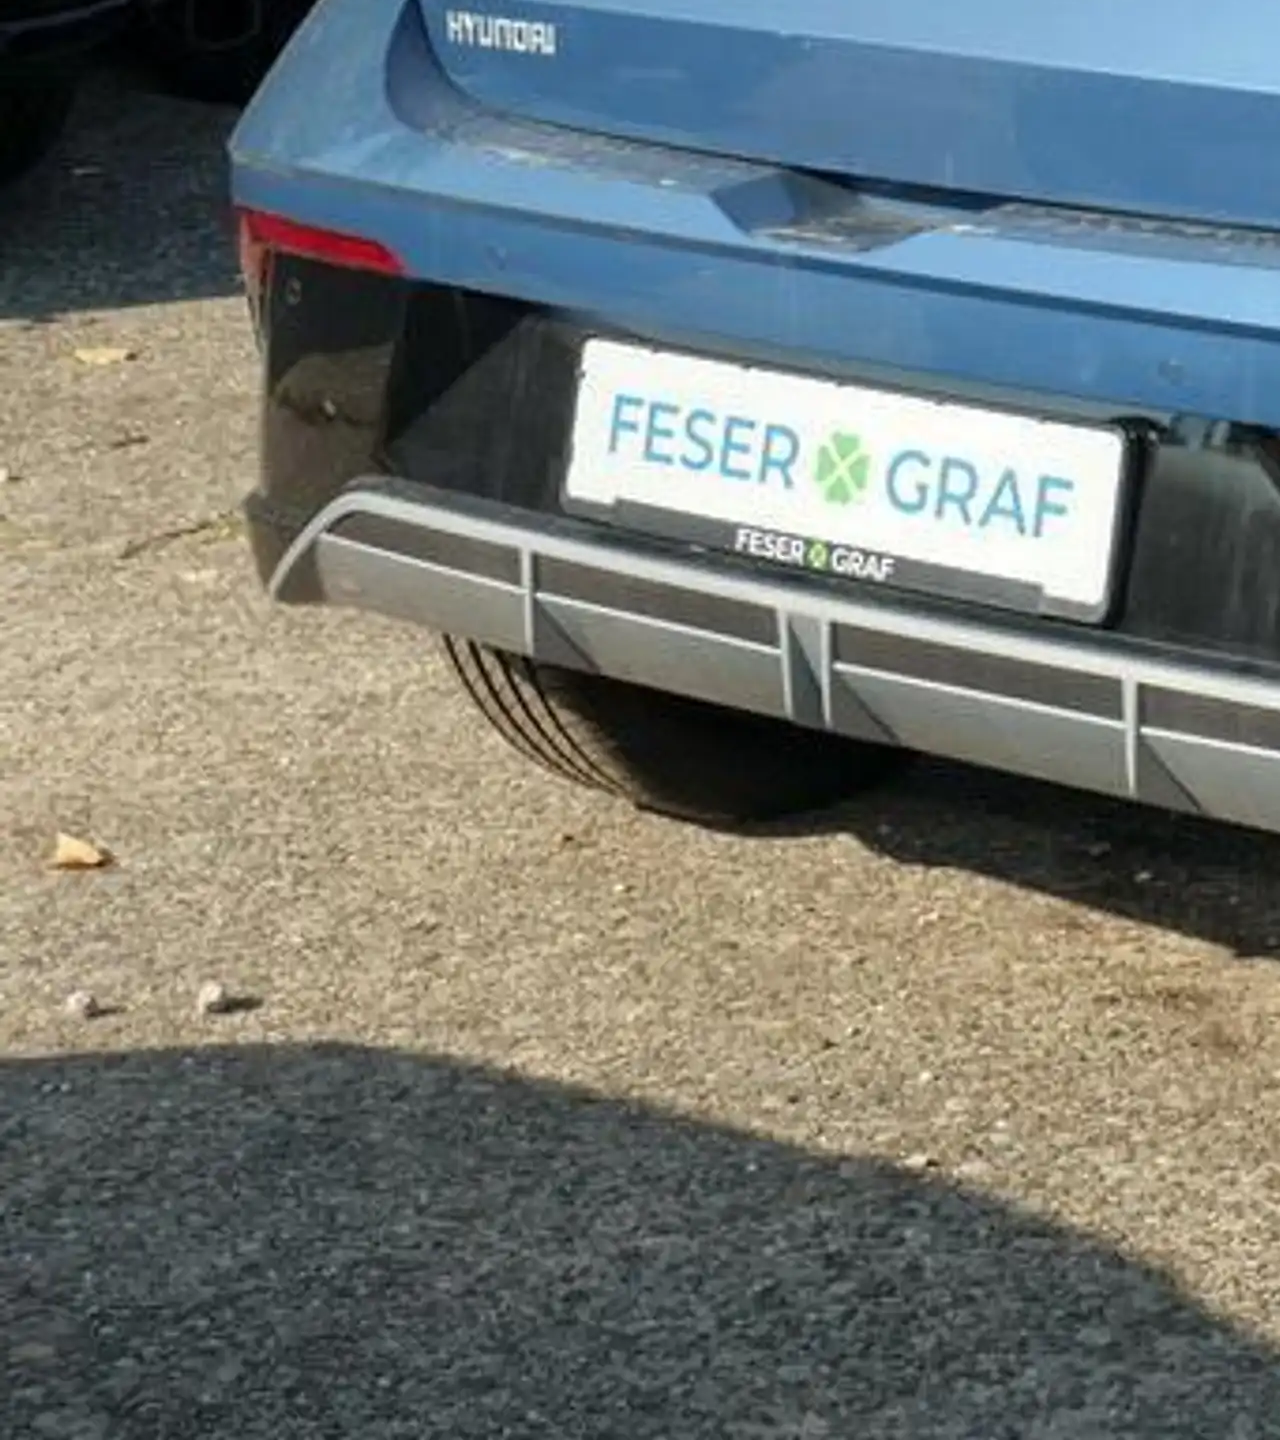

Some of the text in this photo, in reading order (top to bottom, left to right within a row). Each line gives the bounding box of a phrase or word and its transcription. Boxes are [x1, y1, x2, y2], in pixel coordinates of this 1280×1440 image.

[446, 10, 557, 55] HYUNDAI
[607, 392, 1074, 537] FESER GRAF
[735, 528, 896, 582] FESER GRAF
